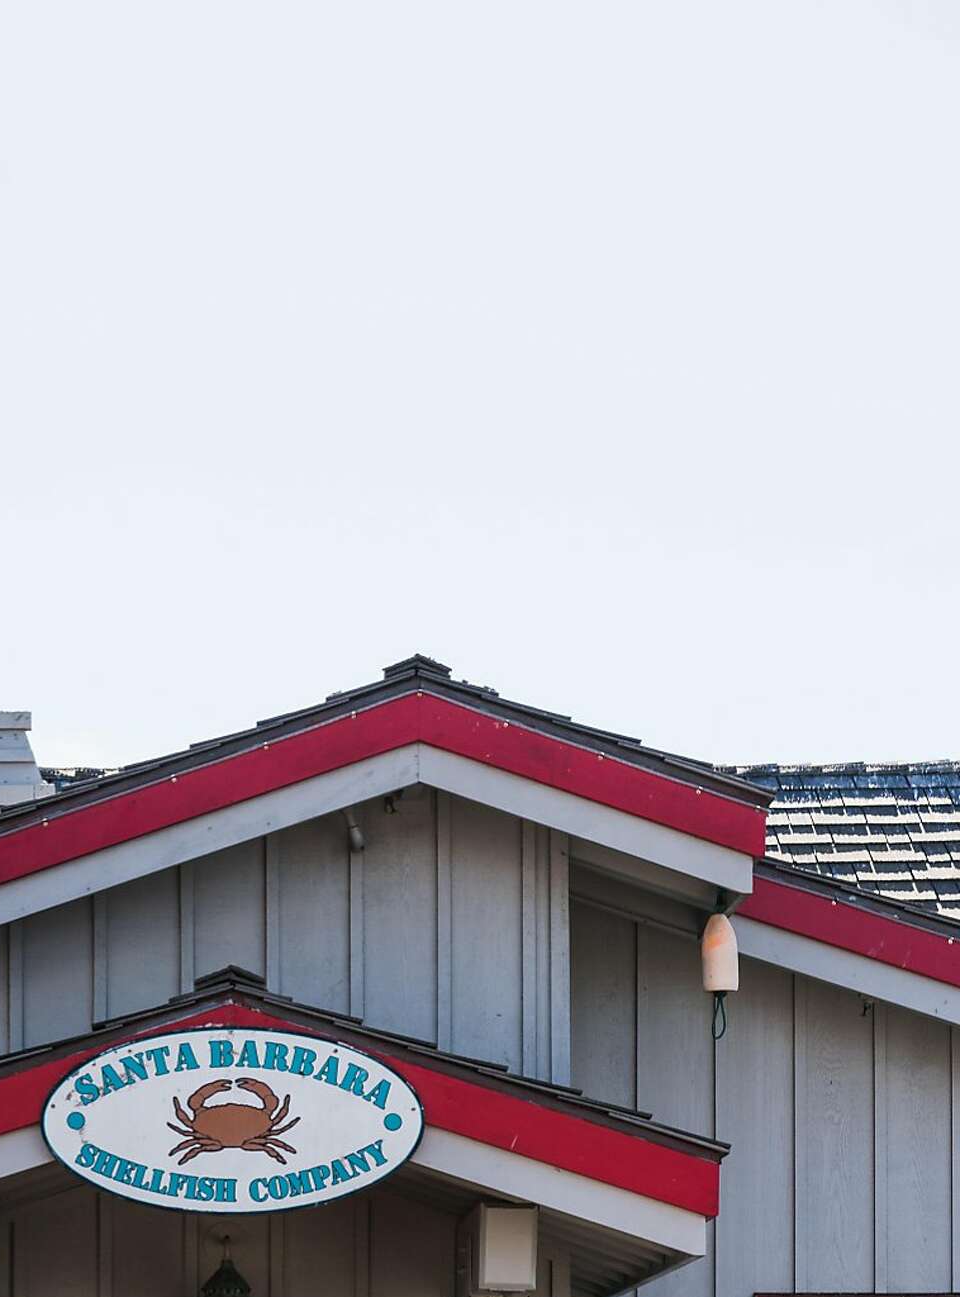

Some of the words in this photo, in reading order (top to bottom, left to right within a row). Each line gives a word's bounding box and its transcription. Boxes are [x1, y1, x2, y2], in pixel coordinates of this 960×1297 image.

[74, 1041, 200, 1106] SANTA
[208, 1040, 392, 1110] BARBARA
[74, 1143, 238, 1203] SHELLFISH
[248, 1140, 388, 1203] COMPANY
